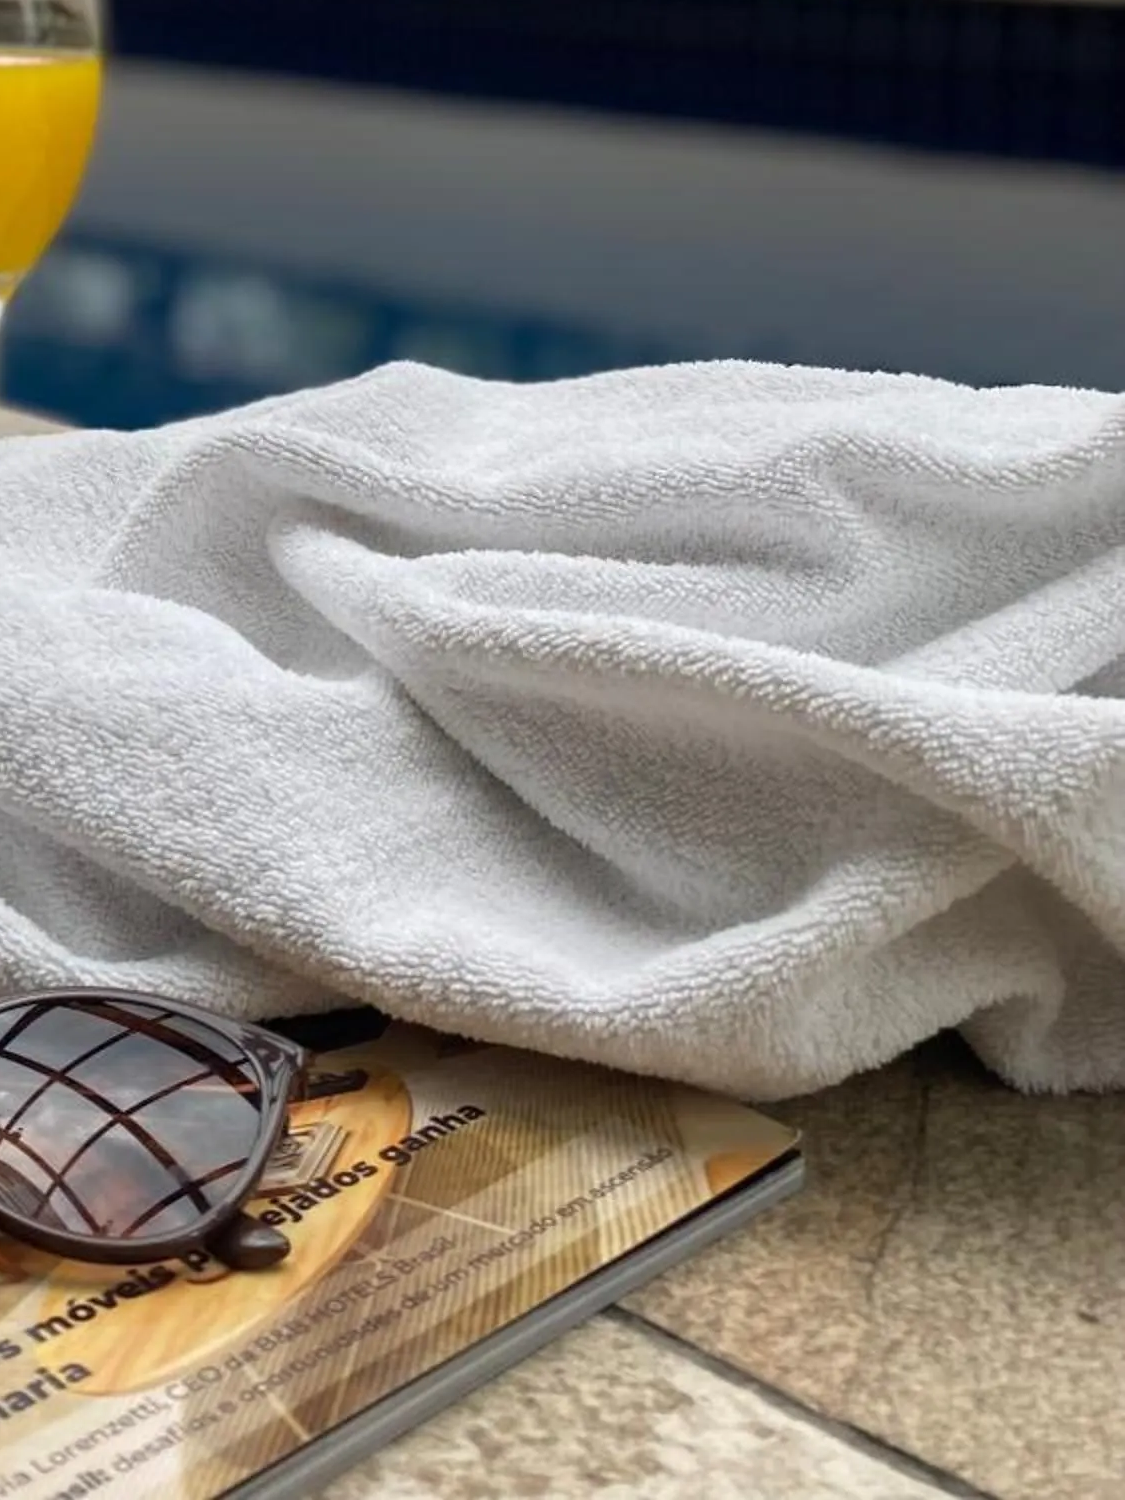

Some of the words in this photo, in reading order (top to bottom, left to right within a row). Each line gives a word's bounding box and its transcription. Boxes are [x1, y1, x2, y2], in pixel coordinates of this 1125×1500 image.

[25, 1264, 176, 1343] móveis
[180, 1160, 378, 1273] pejados
[379, 1102, 485, 1166] ganha
[468, 1214, 557, 1271] mercado
[557, 1191, 594, 1218] em
[30, 1396, 173, 1474] Lorenzetti,
[166, 1365, 222, 1401] CEO
[227, 1348, 256, 1371] da
[305, 1269, 399, 1331] HOTELS
